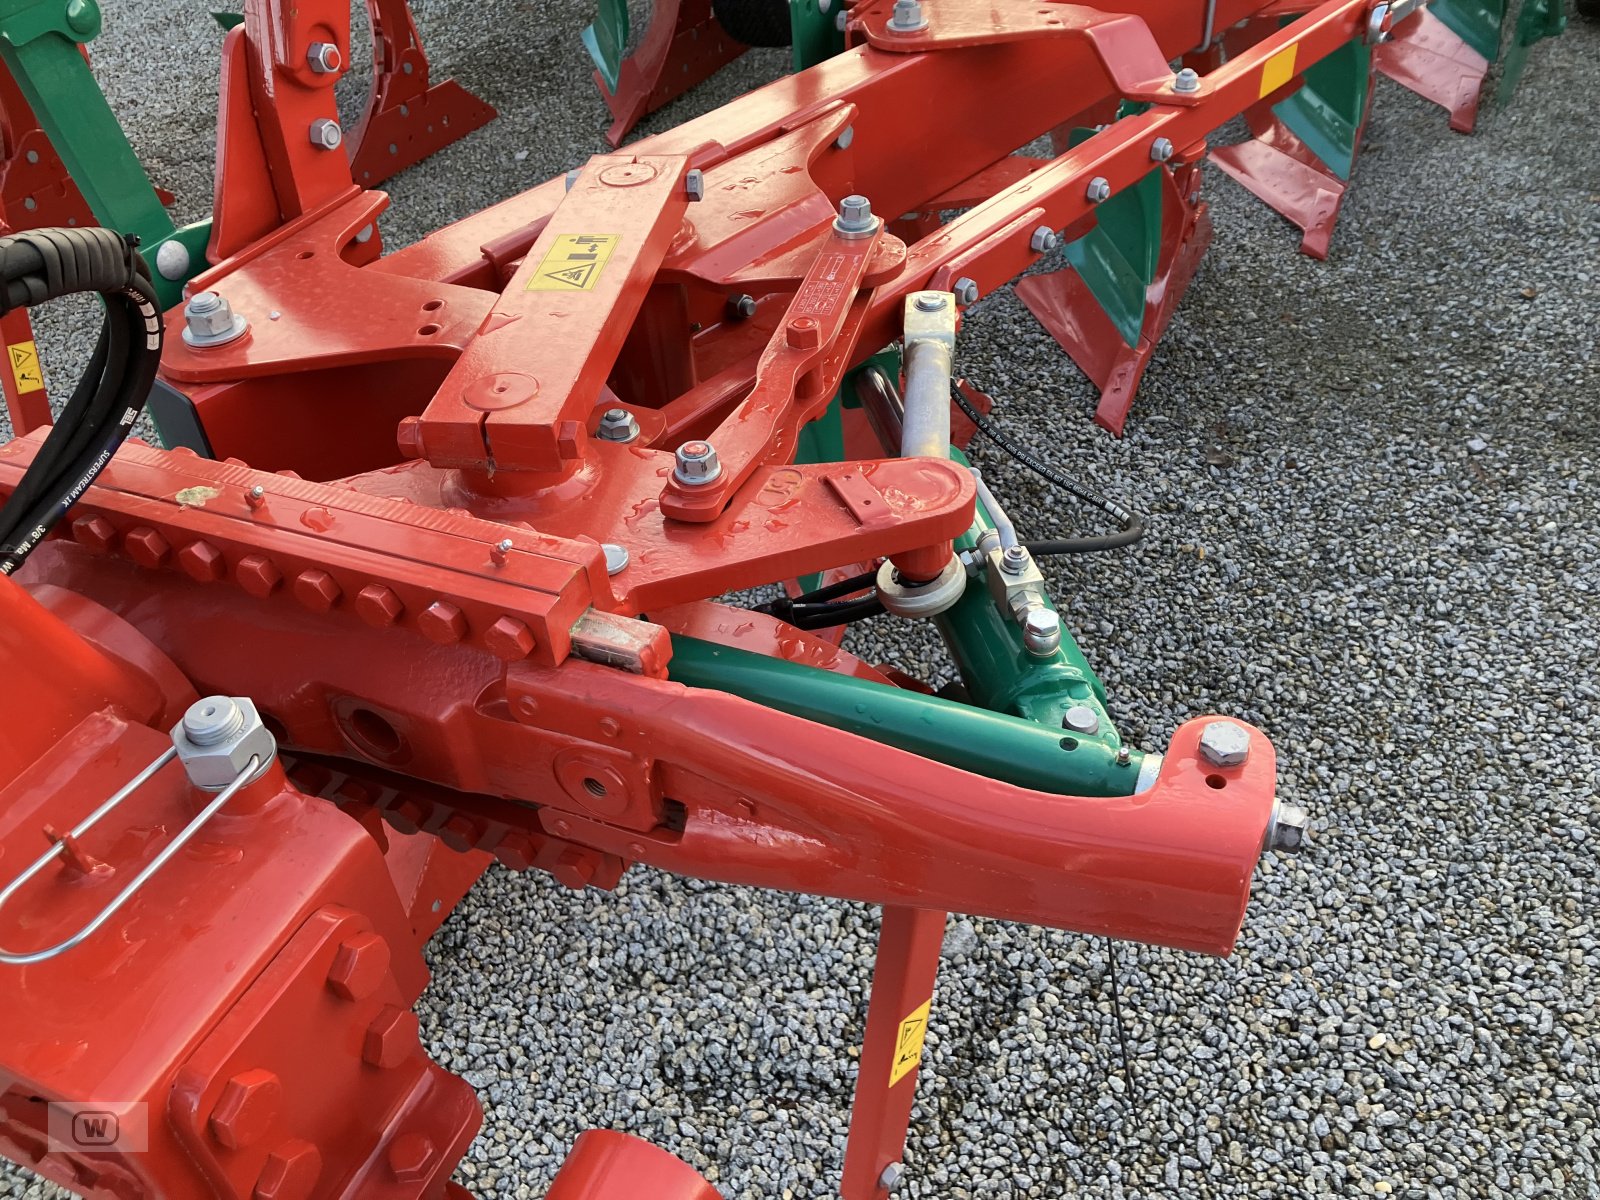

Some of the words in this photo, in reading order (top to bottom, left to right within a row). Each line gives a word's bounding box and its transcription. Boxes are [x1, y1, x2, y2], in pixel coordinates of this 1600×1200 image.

[1016, 450, 1026, 459] PSI
[1025, 456, 1046, 472] EXCEED
[70, 449, 111, 498] SUPERSTREAM
[61, 496, 72, 508] 1K
[14, 540, 32, 556] Ma
